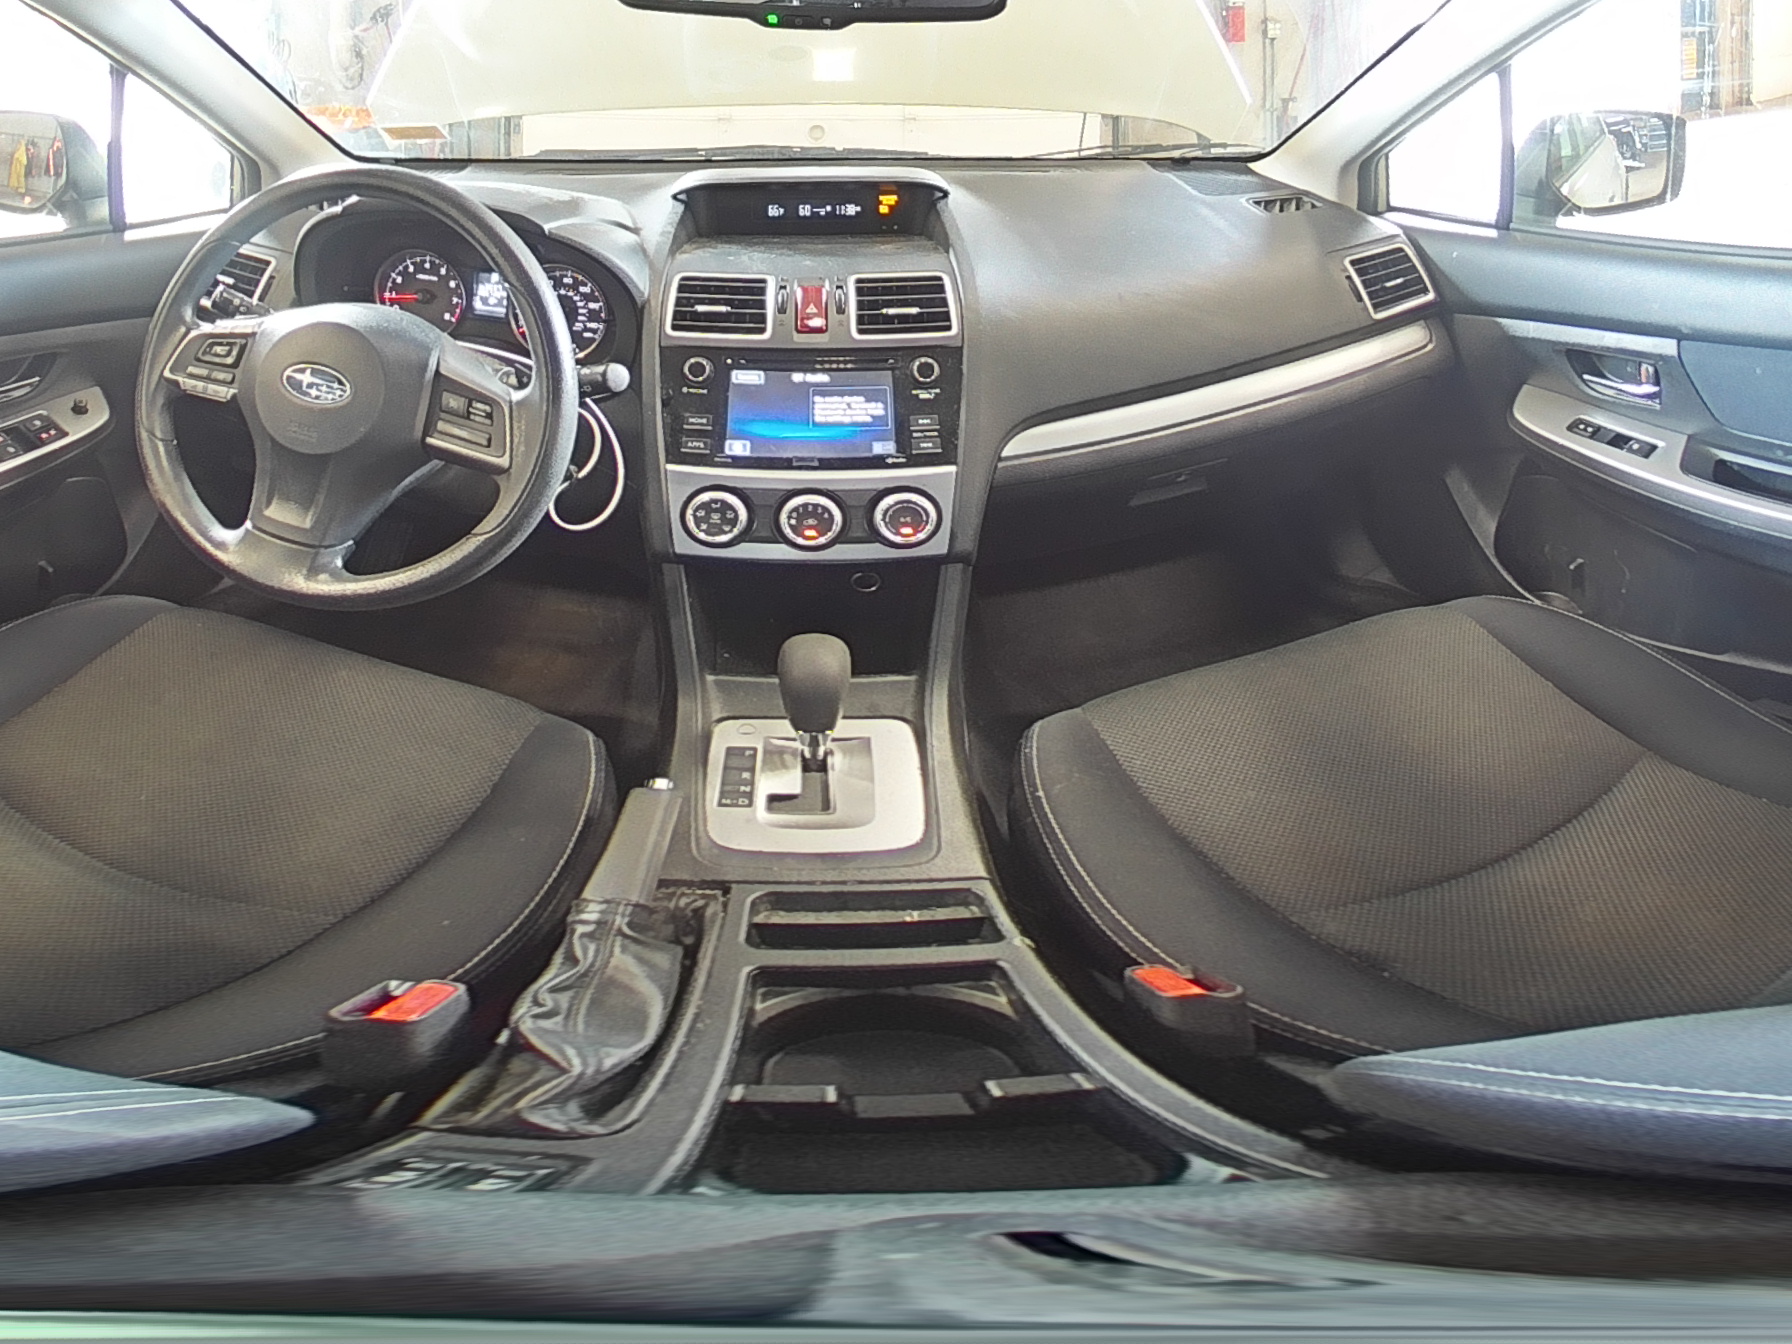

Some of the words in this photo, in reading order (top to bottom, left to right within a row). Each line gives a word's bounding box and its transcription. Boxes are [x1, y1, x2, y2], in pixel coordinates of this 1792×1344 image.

[741, 771, 752, 780] R
[739, 785, 751, 793] N
[738, 797, 749, 805] D
